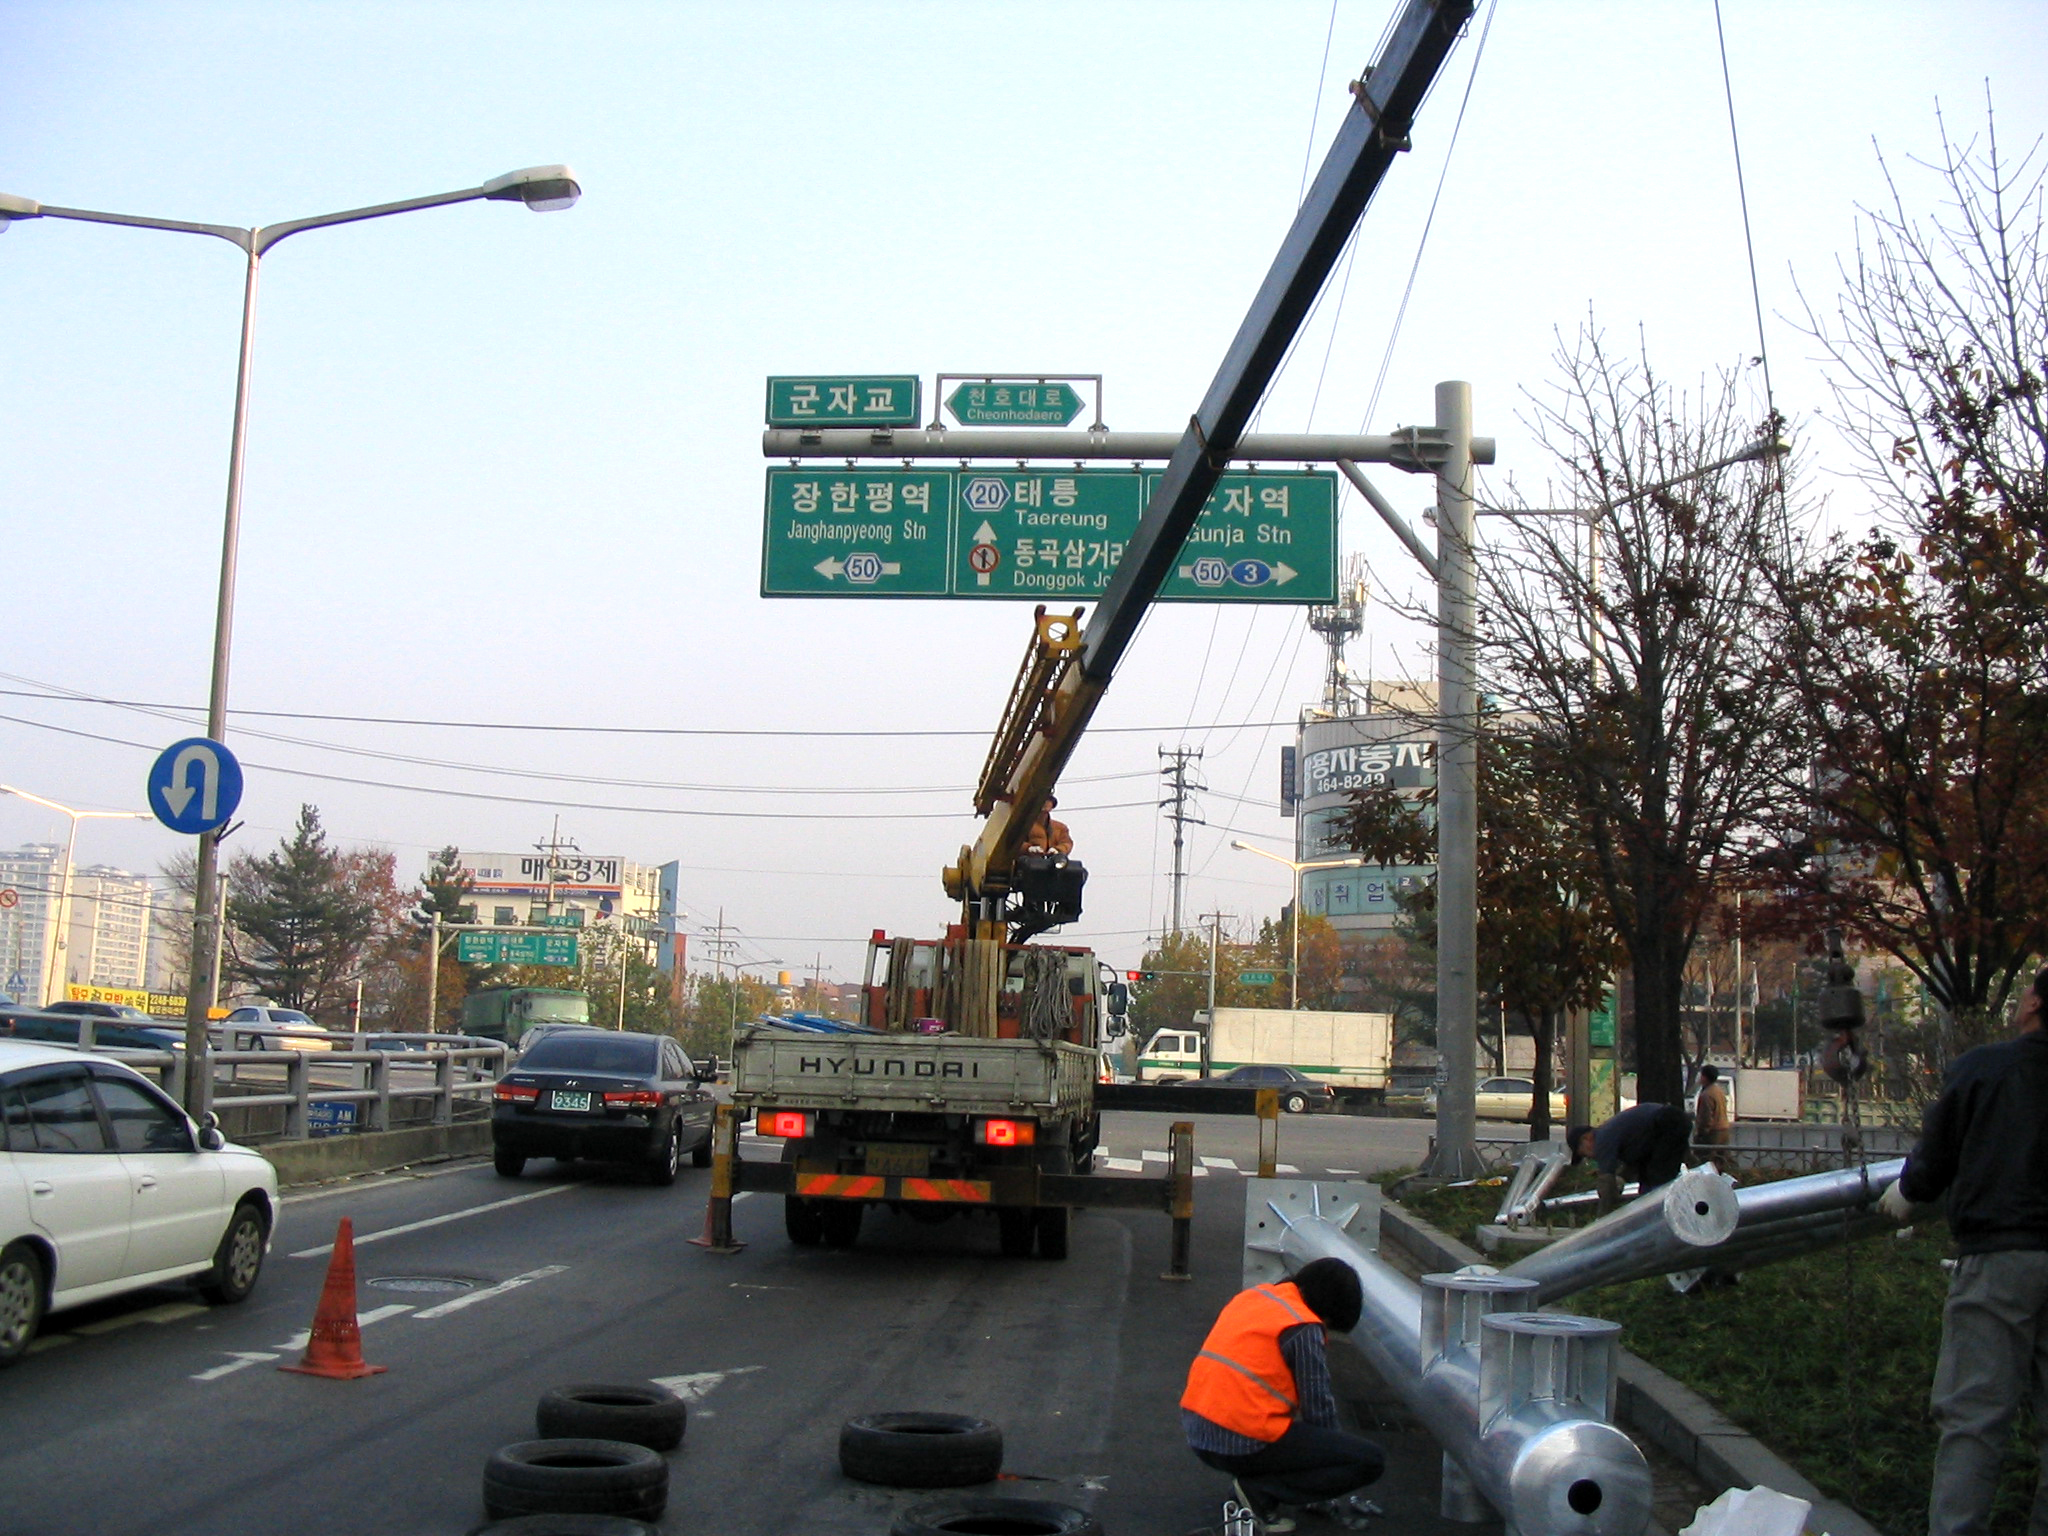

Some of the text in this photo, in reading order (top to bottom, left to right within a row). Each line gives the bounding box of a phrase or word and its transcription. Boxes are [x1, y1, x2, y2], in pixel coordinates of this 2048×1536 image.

[789, 384, 894, 414] 군자교
[968, 387, 1063, 407] 천호대로
[967, 408, 1062, 421] Cheonhodaero
[791, 482, 930, 513] 장한평역
[975, 484, 999, 505] 20
[1014, 478, 1078, 507] 태릉
[1015, 511, 1107, 530] Taereung
[787, 519, 926, 543] Janghanpyeong Stn
[1257, 523, 1292, 545] Stn
[851, 559, 875, 578] 50
[1200, 563, 1257, 582] 50 3
[1014, 570, 1085, 590] Donggok
[800, 1057, 979, 1079] HYUNDAI
[555, 1097, 587, 1109] 9345
